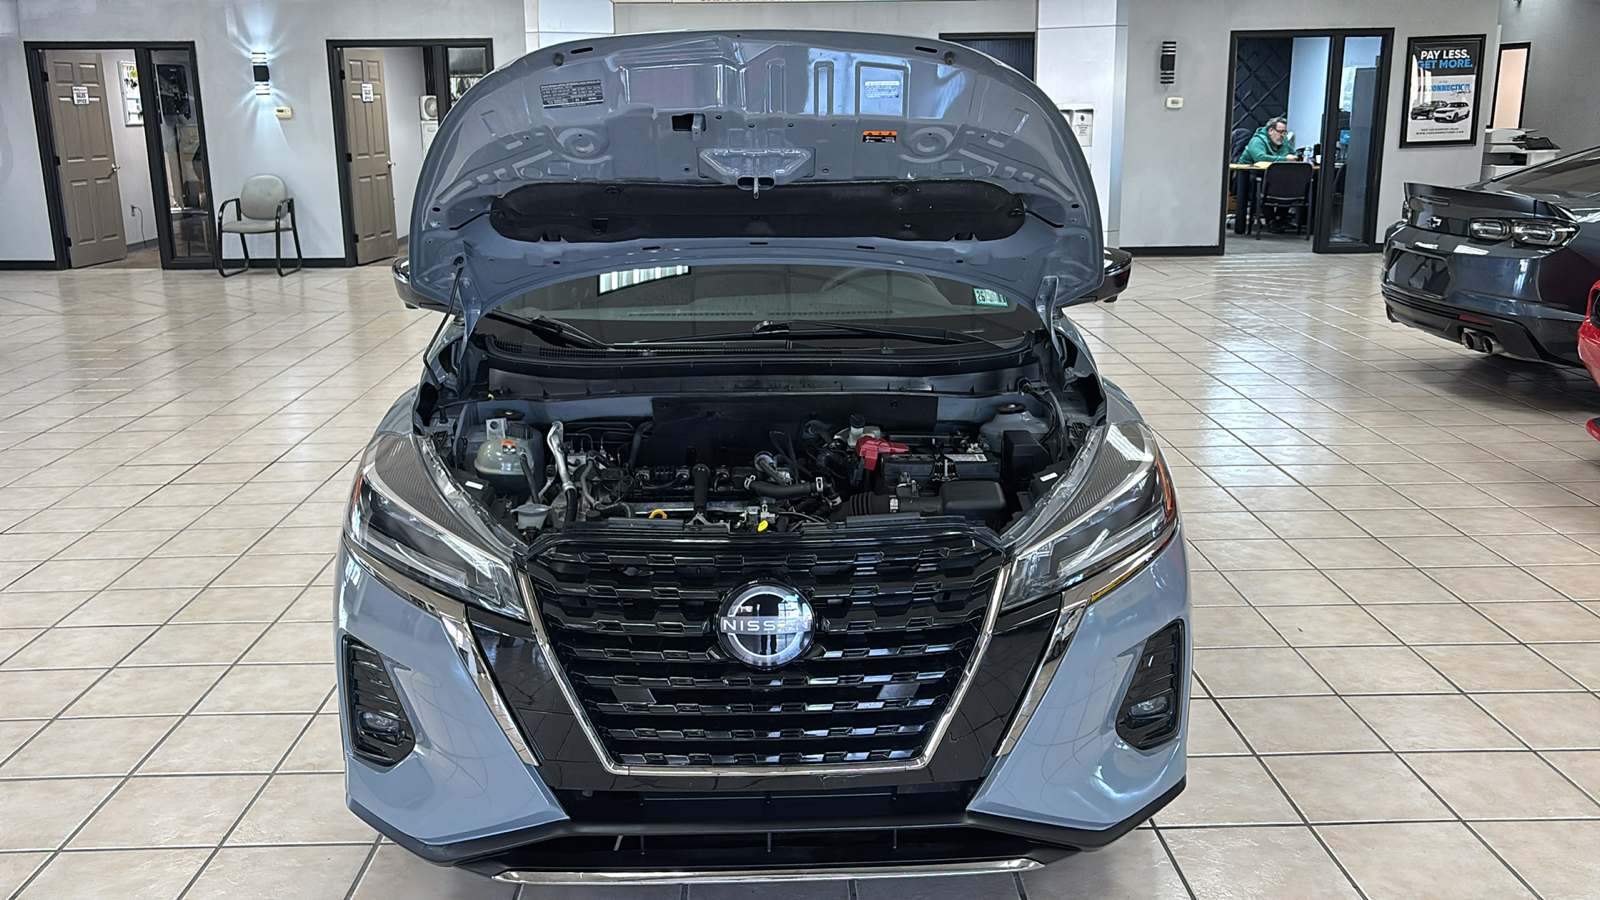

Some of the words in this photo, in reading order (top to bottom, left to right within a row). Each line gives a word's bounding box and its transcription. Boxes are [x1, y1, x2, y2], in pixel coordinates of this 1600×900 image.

[1420, 50, 1441, 60] PAY
[1443, 49, 1470, 59] LESS.
[1417, 60, 1438, 69] GET
[1439, 59, 1473, 69] MORE.
[976, 290, 986, 302] 26
[723, 619, 809, 632] NISSN
